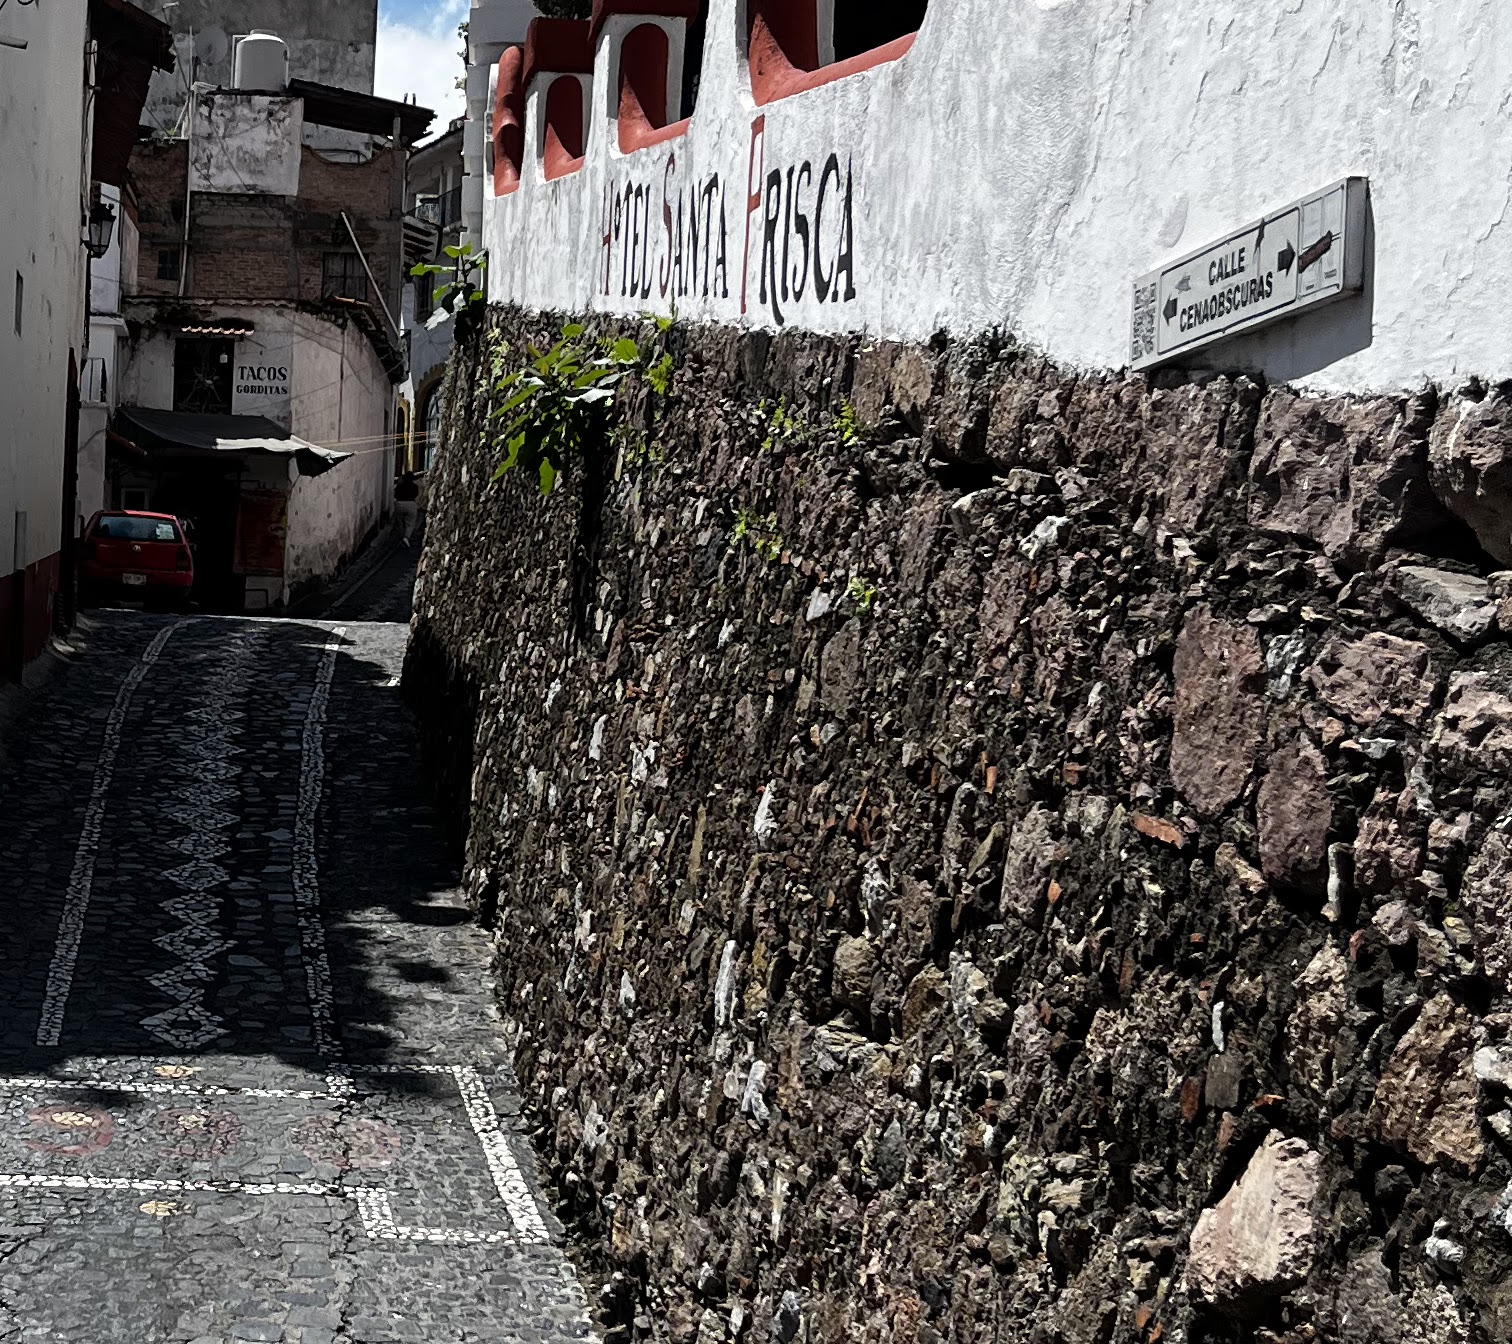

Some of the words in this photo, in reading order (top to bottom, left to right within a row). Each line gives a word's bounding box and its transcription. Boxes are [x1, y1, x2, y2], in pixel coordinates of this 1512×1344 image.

[599, 179, 651, 300] HOTEL
[659, 152, 729, 300] SANTA
[740, 112, 856, 326] PRISCA
[1208, 246, 1245, 286] CALLE
[1179, 271, 1273, 332] CENAOBSCURAS
[236, 384, 288, 395] GORDITAS
[238, 366, 288, 381] TACOS
